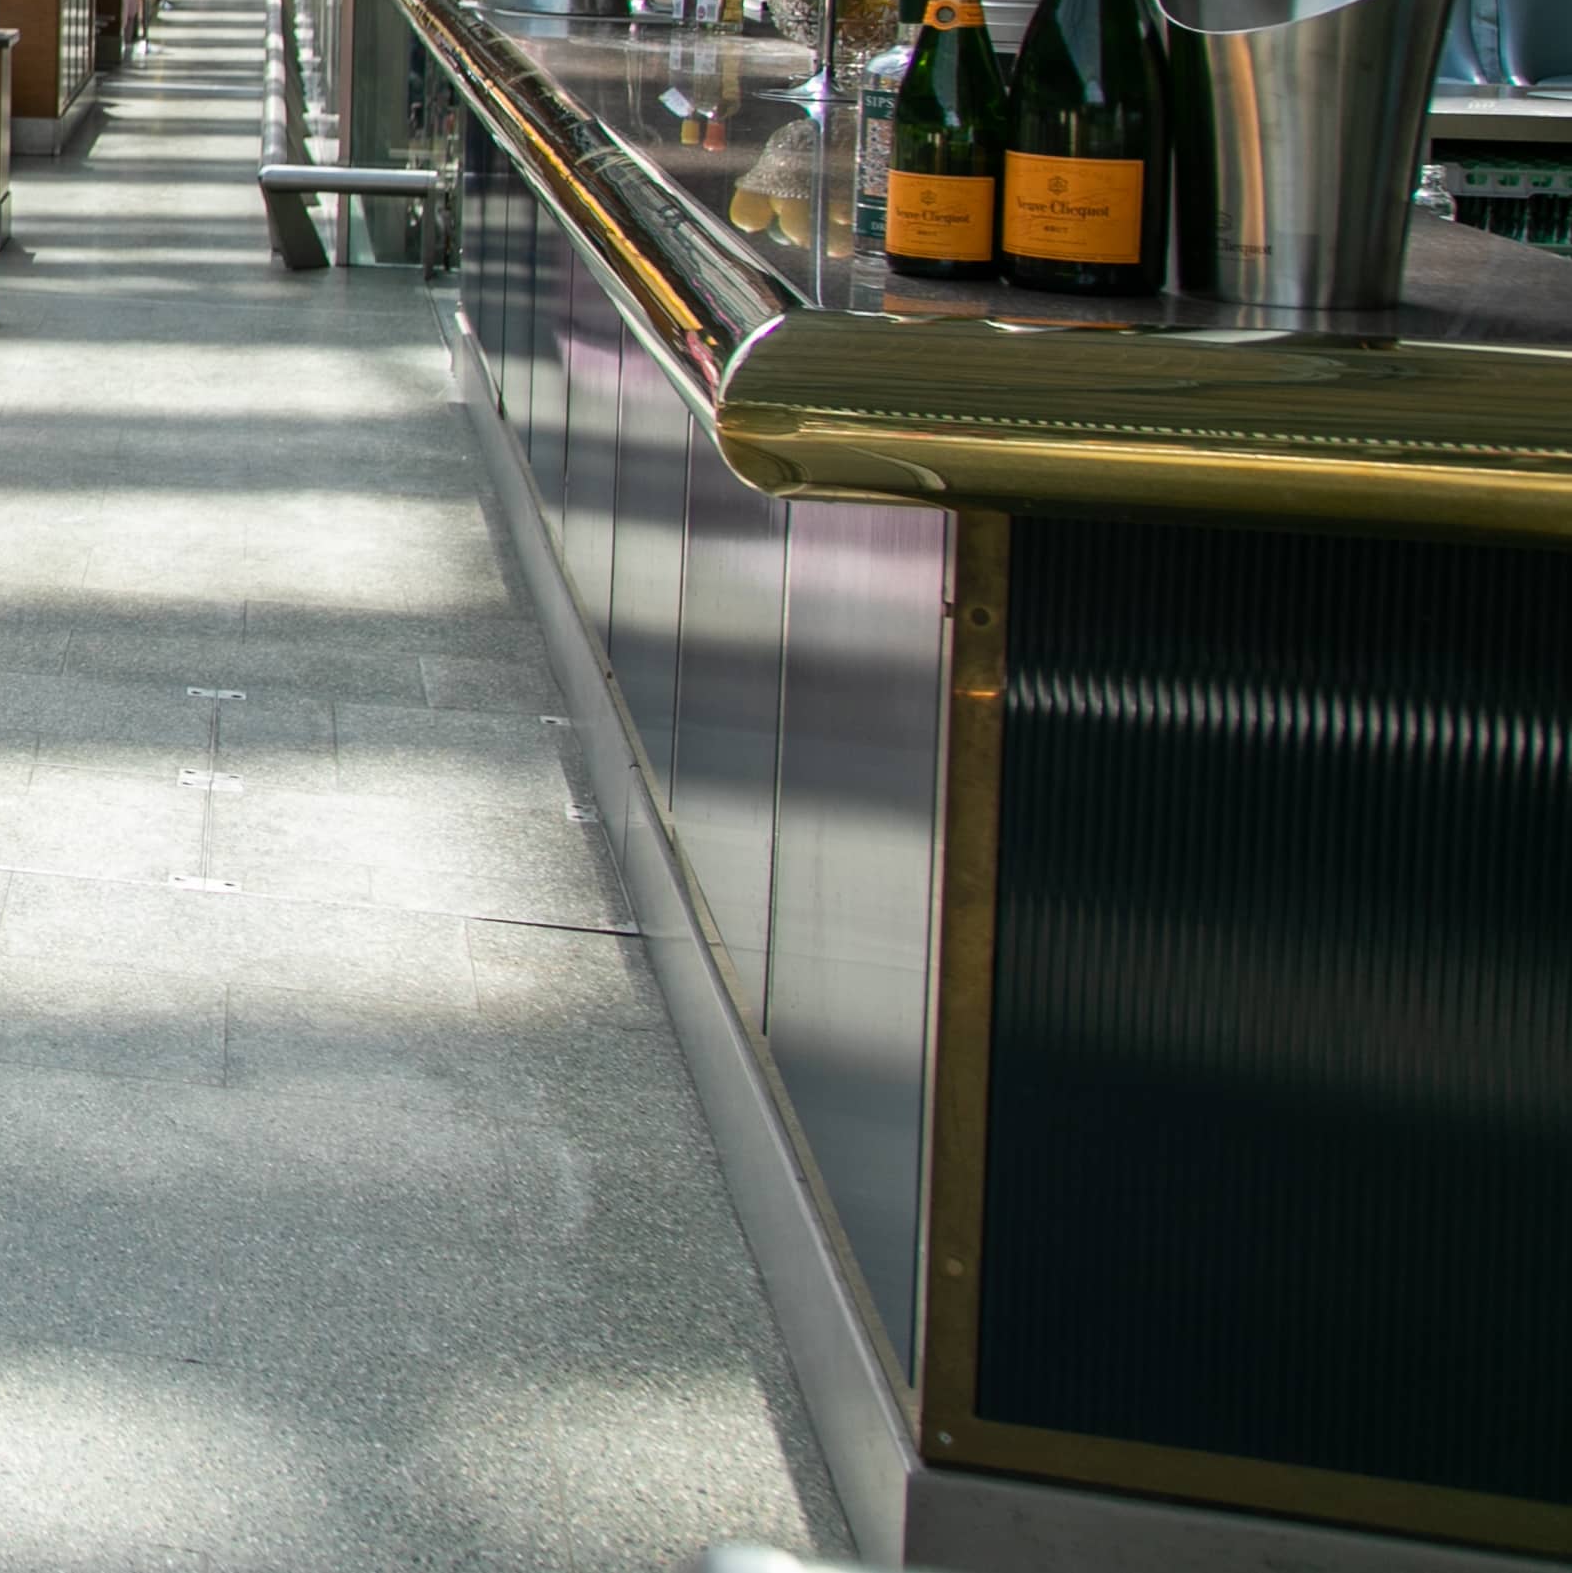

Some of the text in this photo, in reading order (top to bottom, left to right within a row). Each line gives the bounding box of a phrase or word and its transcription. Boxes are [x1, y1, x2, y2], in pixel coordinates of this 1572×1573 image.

[864, 95, 896, 109] SIPS
[1015, 195, 1111, 220] Veuve Clicquot
